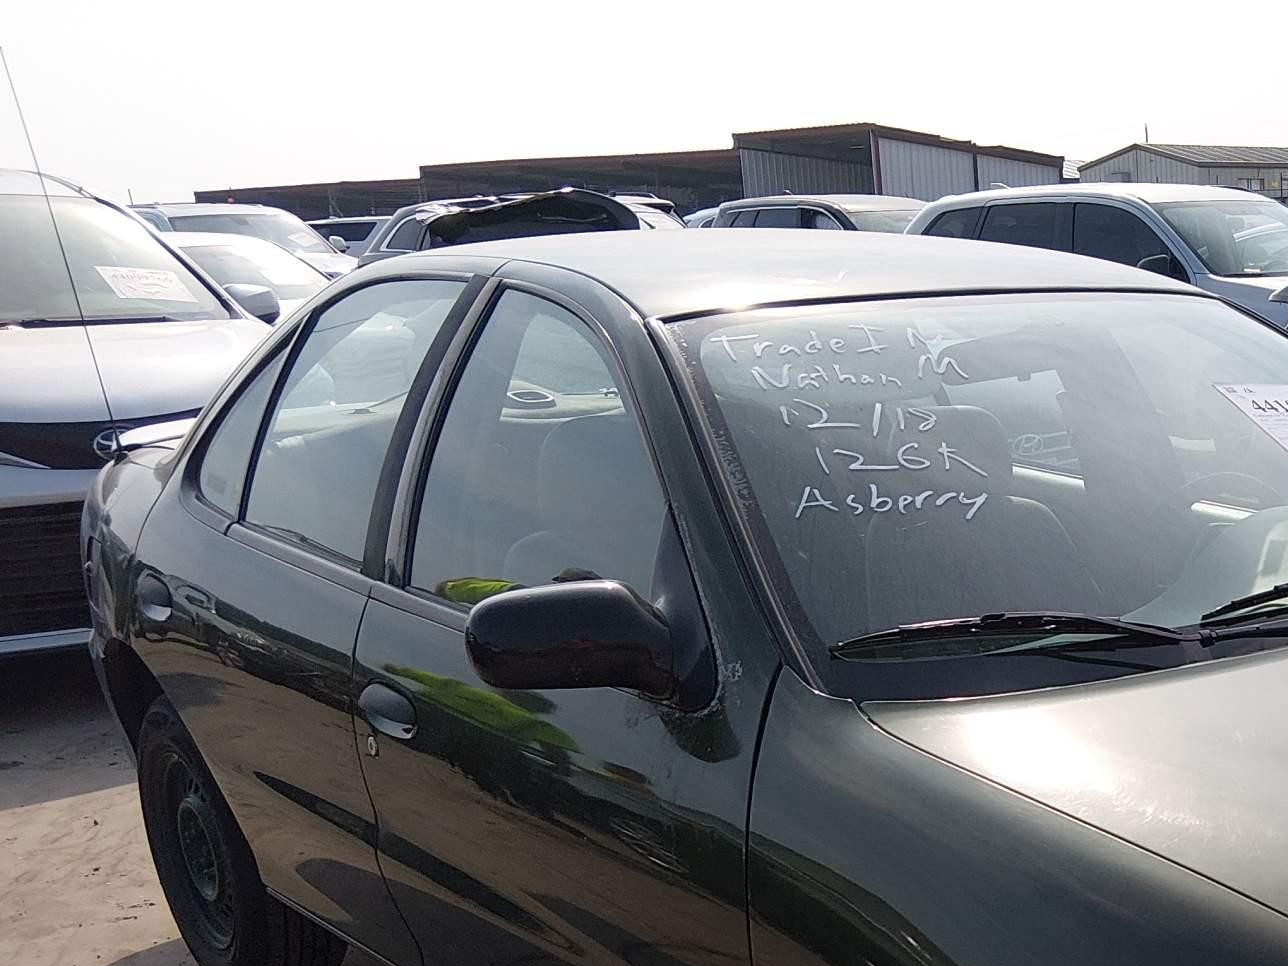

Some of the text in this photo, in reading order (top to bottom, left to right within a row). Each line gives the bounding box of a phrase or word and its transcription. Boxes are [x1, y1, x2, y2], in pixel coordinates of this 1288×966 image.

[710, 329, 847, 361] Trade
[751, 353, 969, 390] Nathan M
[794, 484, 988, 520] Asberry
